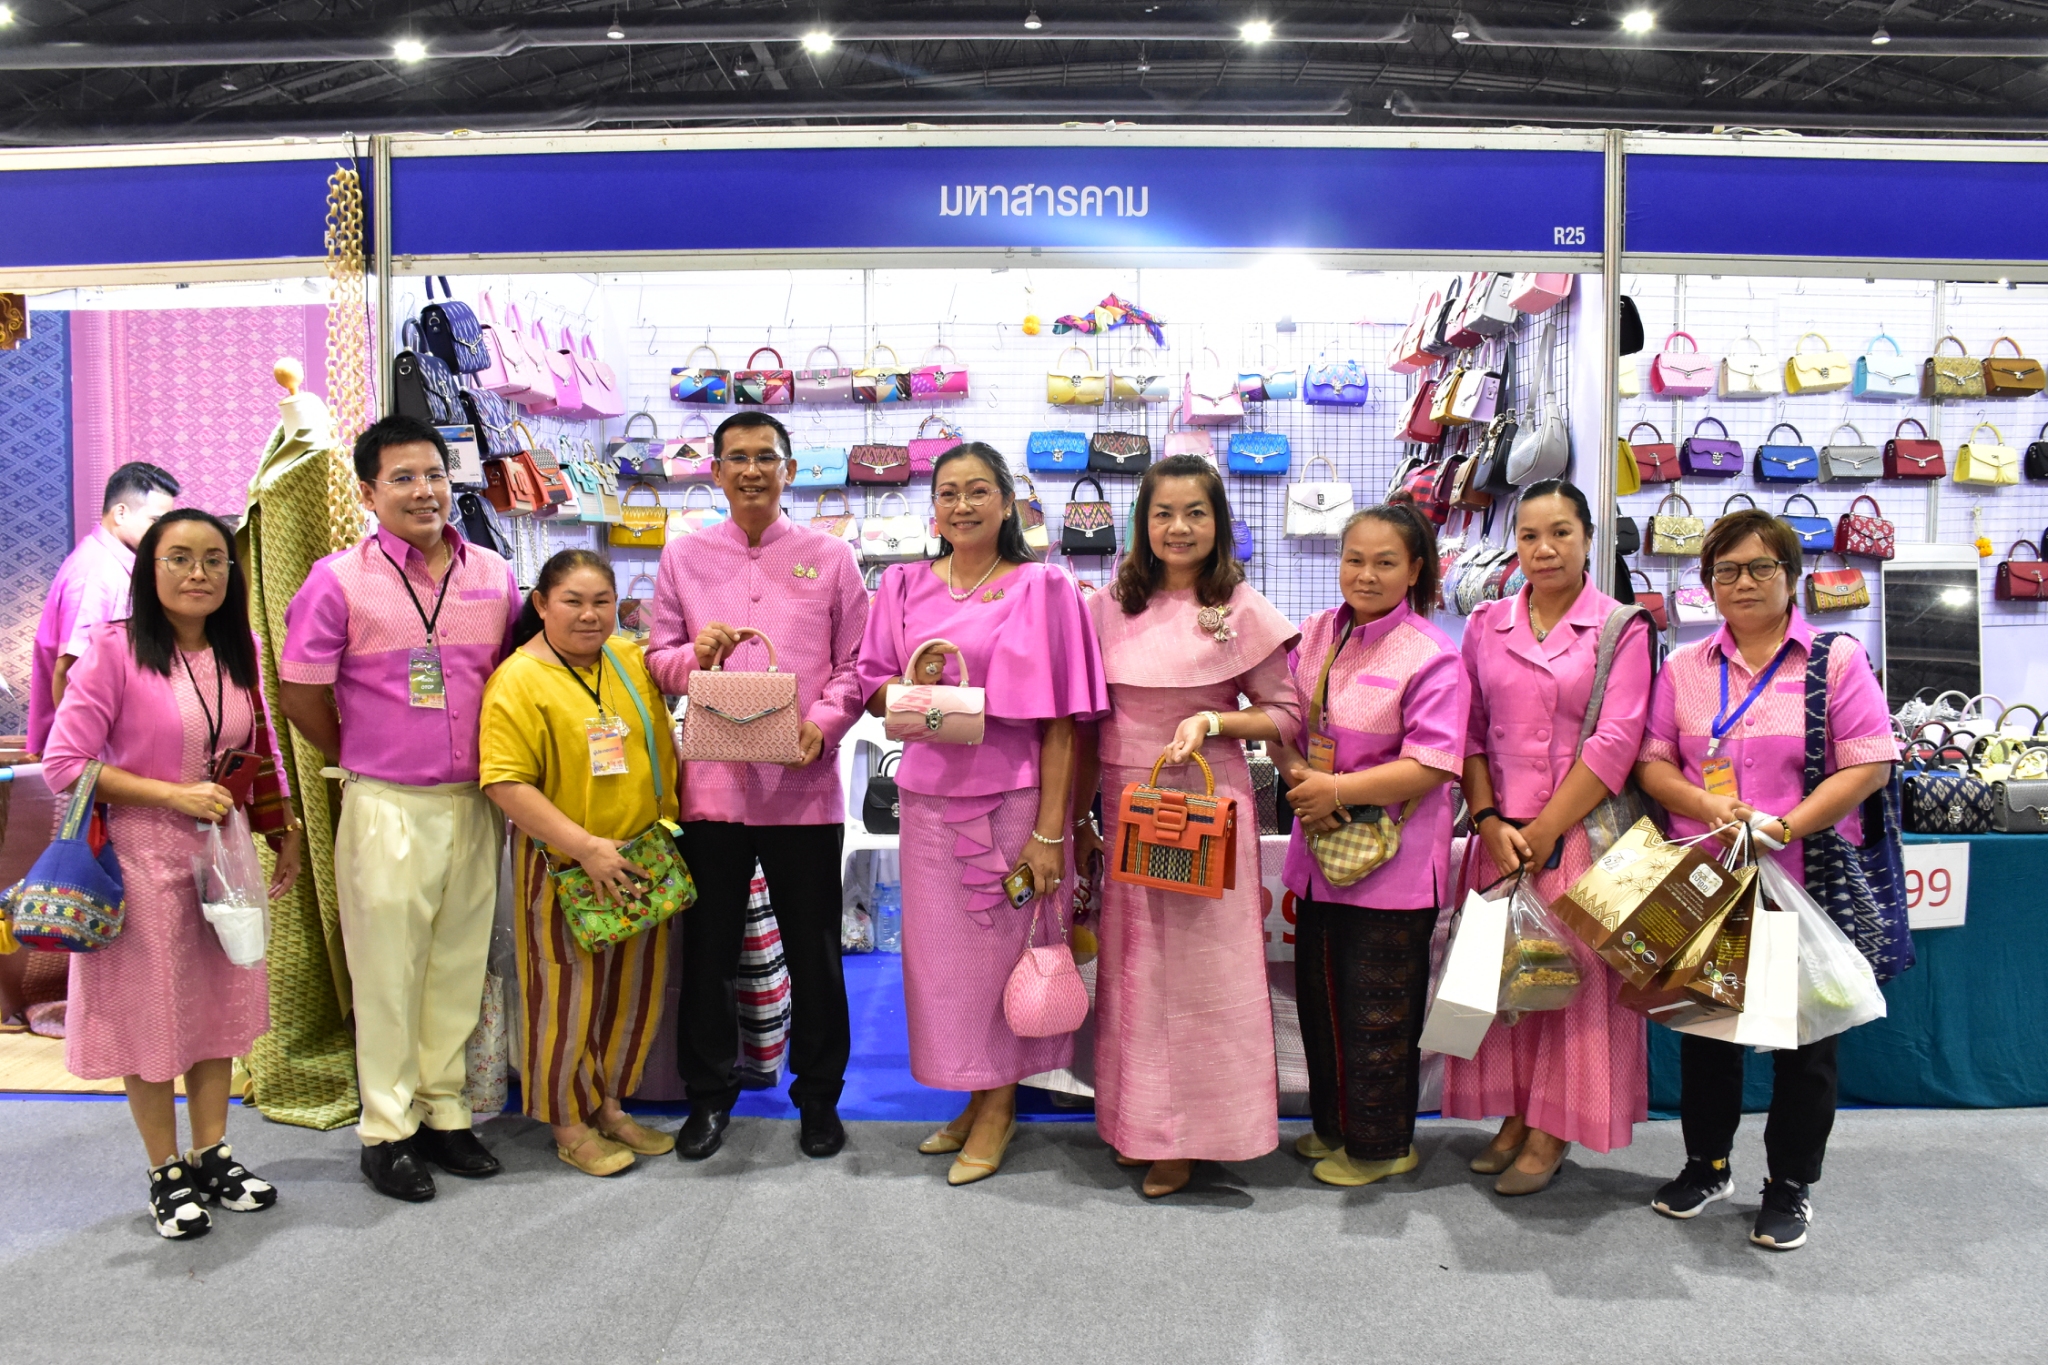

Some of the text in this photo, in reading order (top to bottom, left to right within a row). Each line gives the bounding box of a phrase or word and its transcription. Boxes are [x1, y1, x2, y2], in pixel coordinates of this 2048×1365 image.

[939, 183, 1149, 217] มหาสารคาม
[1553, 226, 1586, 245] R25
